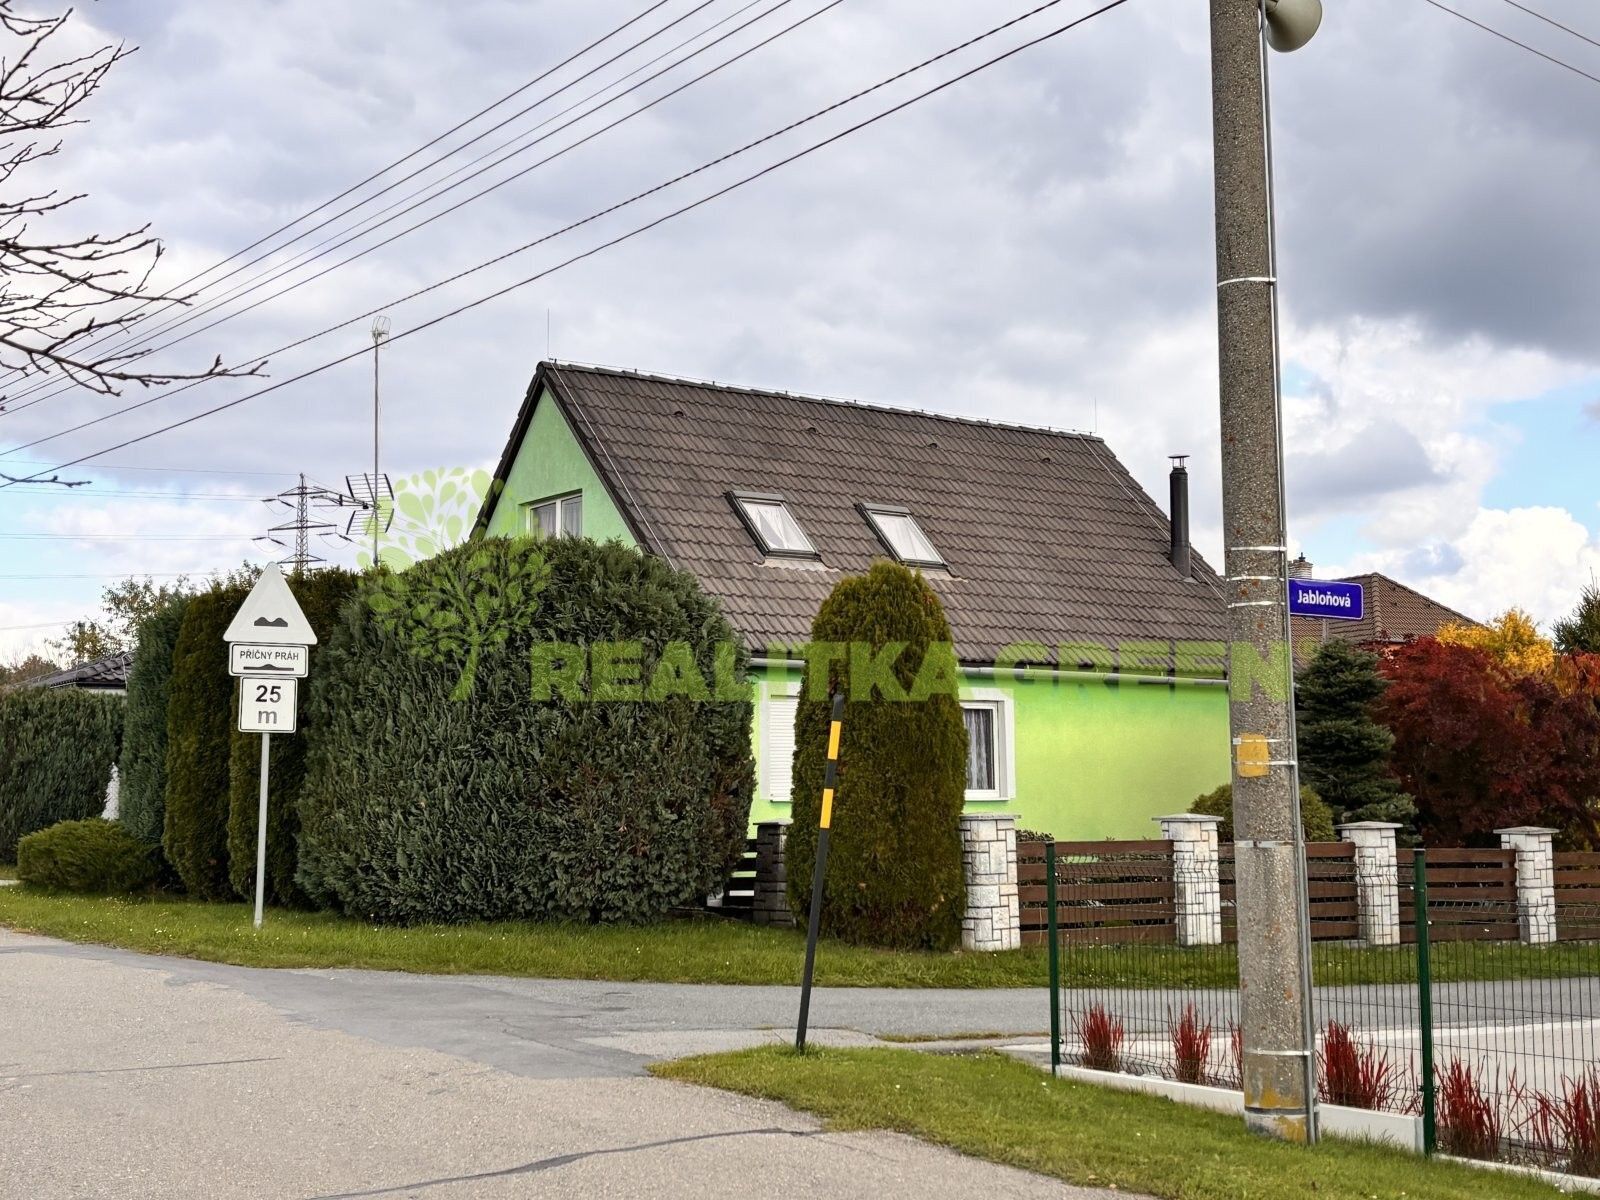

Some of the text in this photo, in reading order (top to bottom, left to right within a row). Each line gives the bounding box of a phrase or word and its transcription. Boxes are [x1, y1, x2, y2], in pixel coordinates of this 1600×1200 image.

[1297, 589, 1351, 608] Jabloňová
[240, 649, 299, 661] PŘÍČNÝ PRÁH
[255, 684, 282, 703] 25
[257, 710, 278, 725] m
